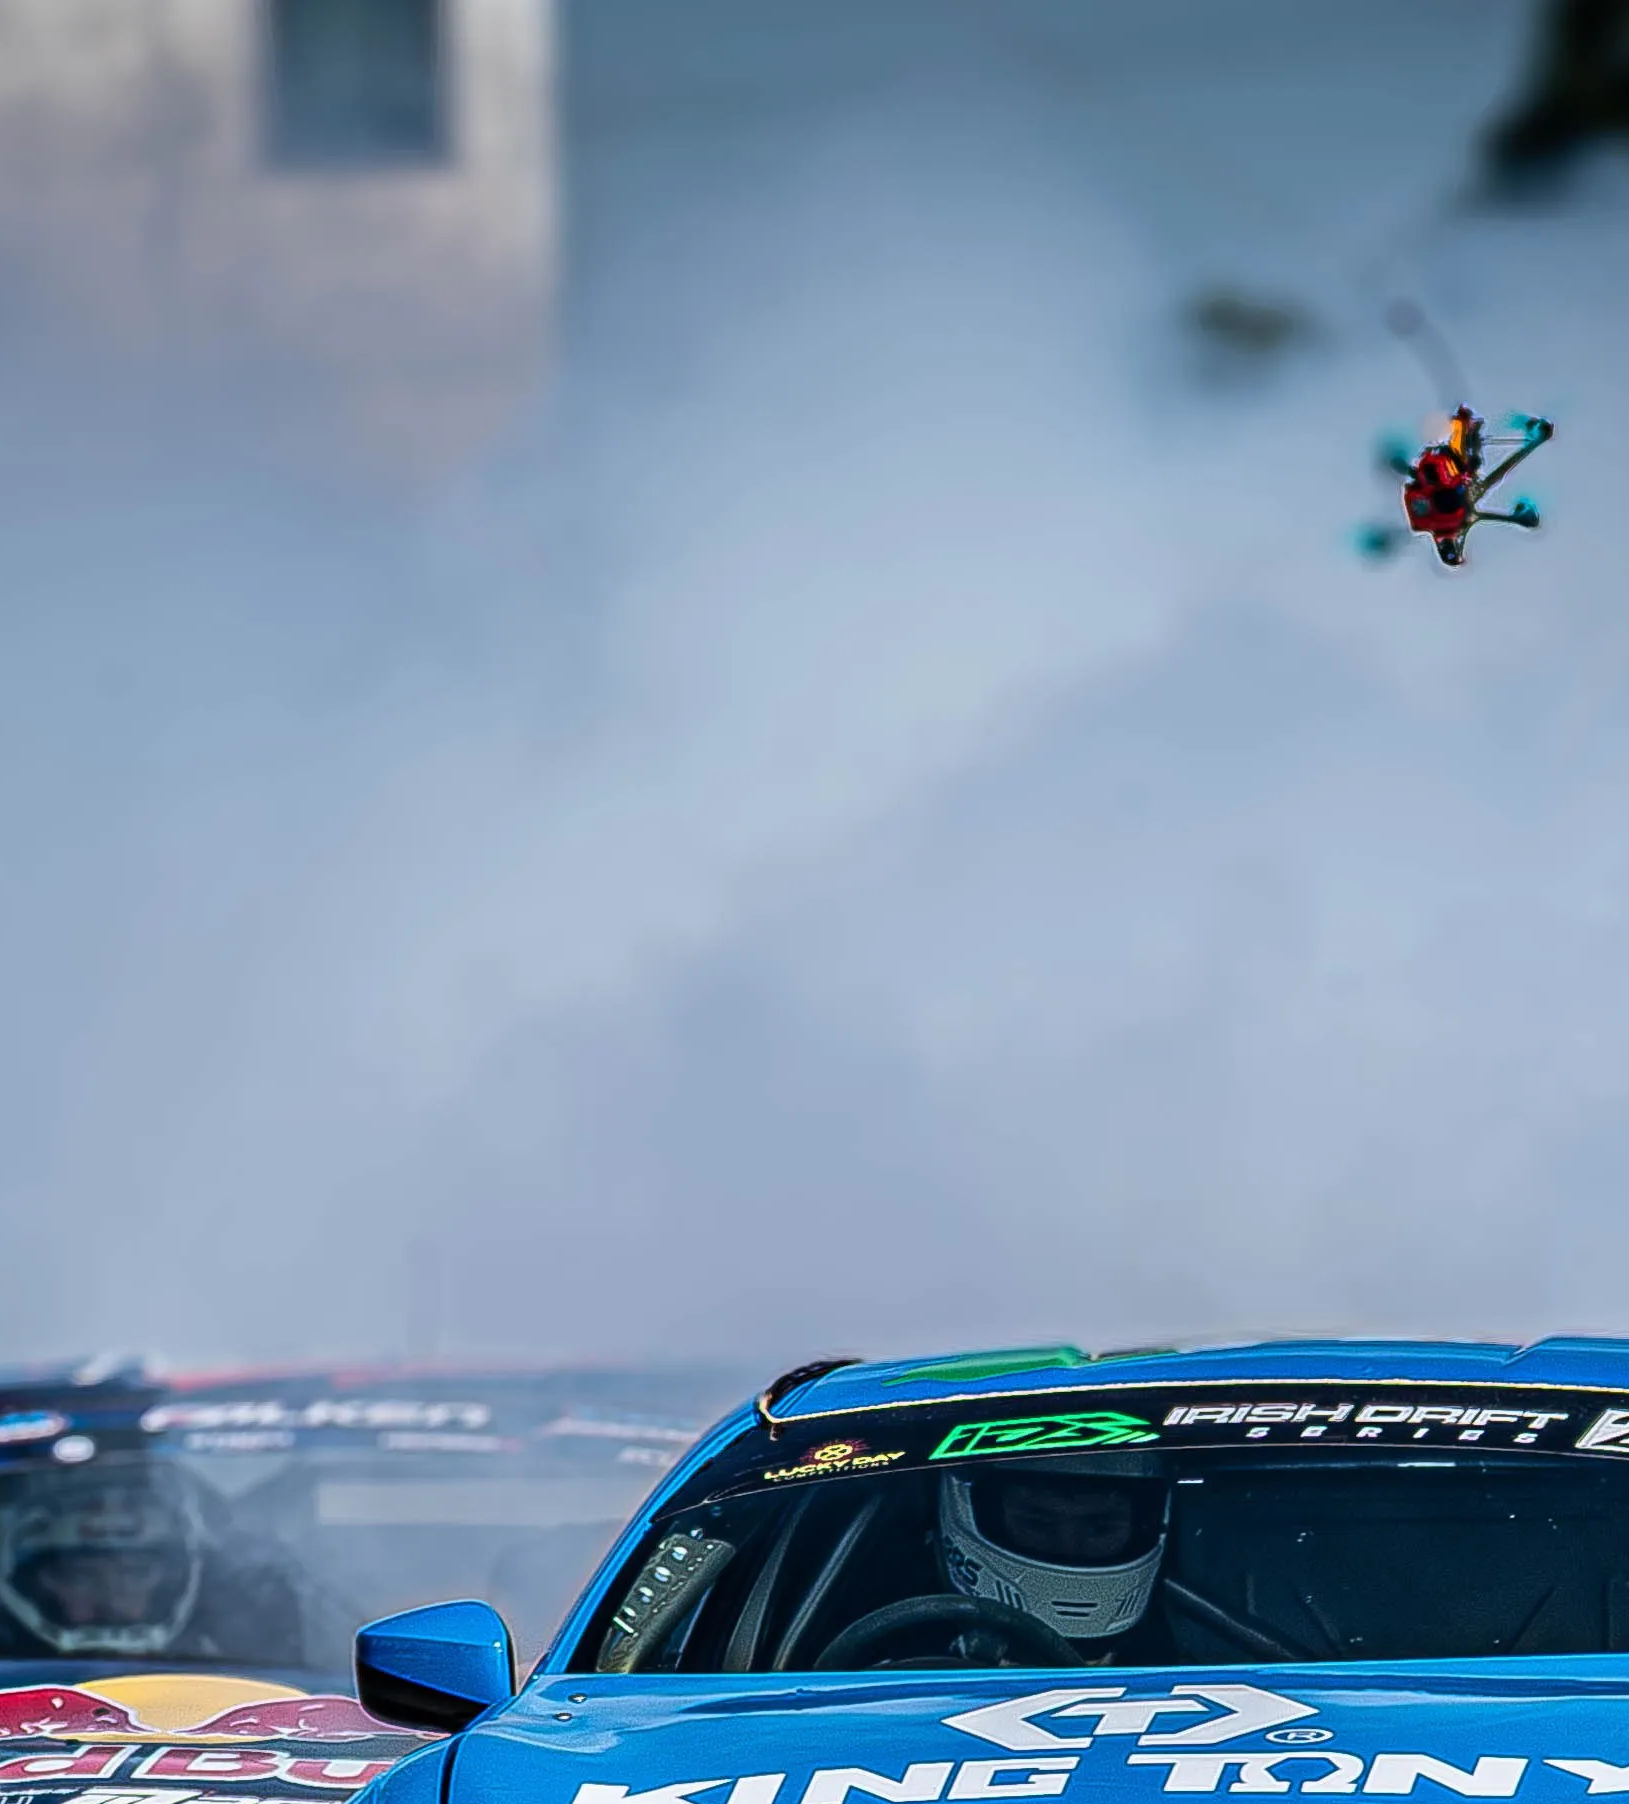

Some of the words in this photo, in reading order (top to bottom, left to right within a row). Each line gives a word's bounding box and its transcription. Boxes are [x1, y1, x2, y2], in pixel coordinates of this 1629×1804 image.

[1163, 1403, 1355, 1426] IRISH
[1355, 1404, 1569, 1429] DRIFT
[1246, 1426, 1538, 1443] SERIES
[764, 1458, 850, 1480] LUCKY
[852, 1451, 906, 1466] DAY
[130, 1746, 397, 1789] Bu
